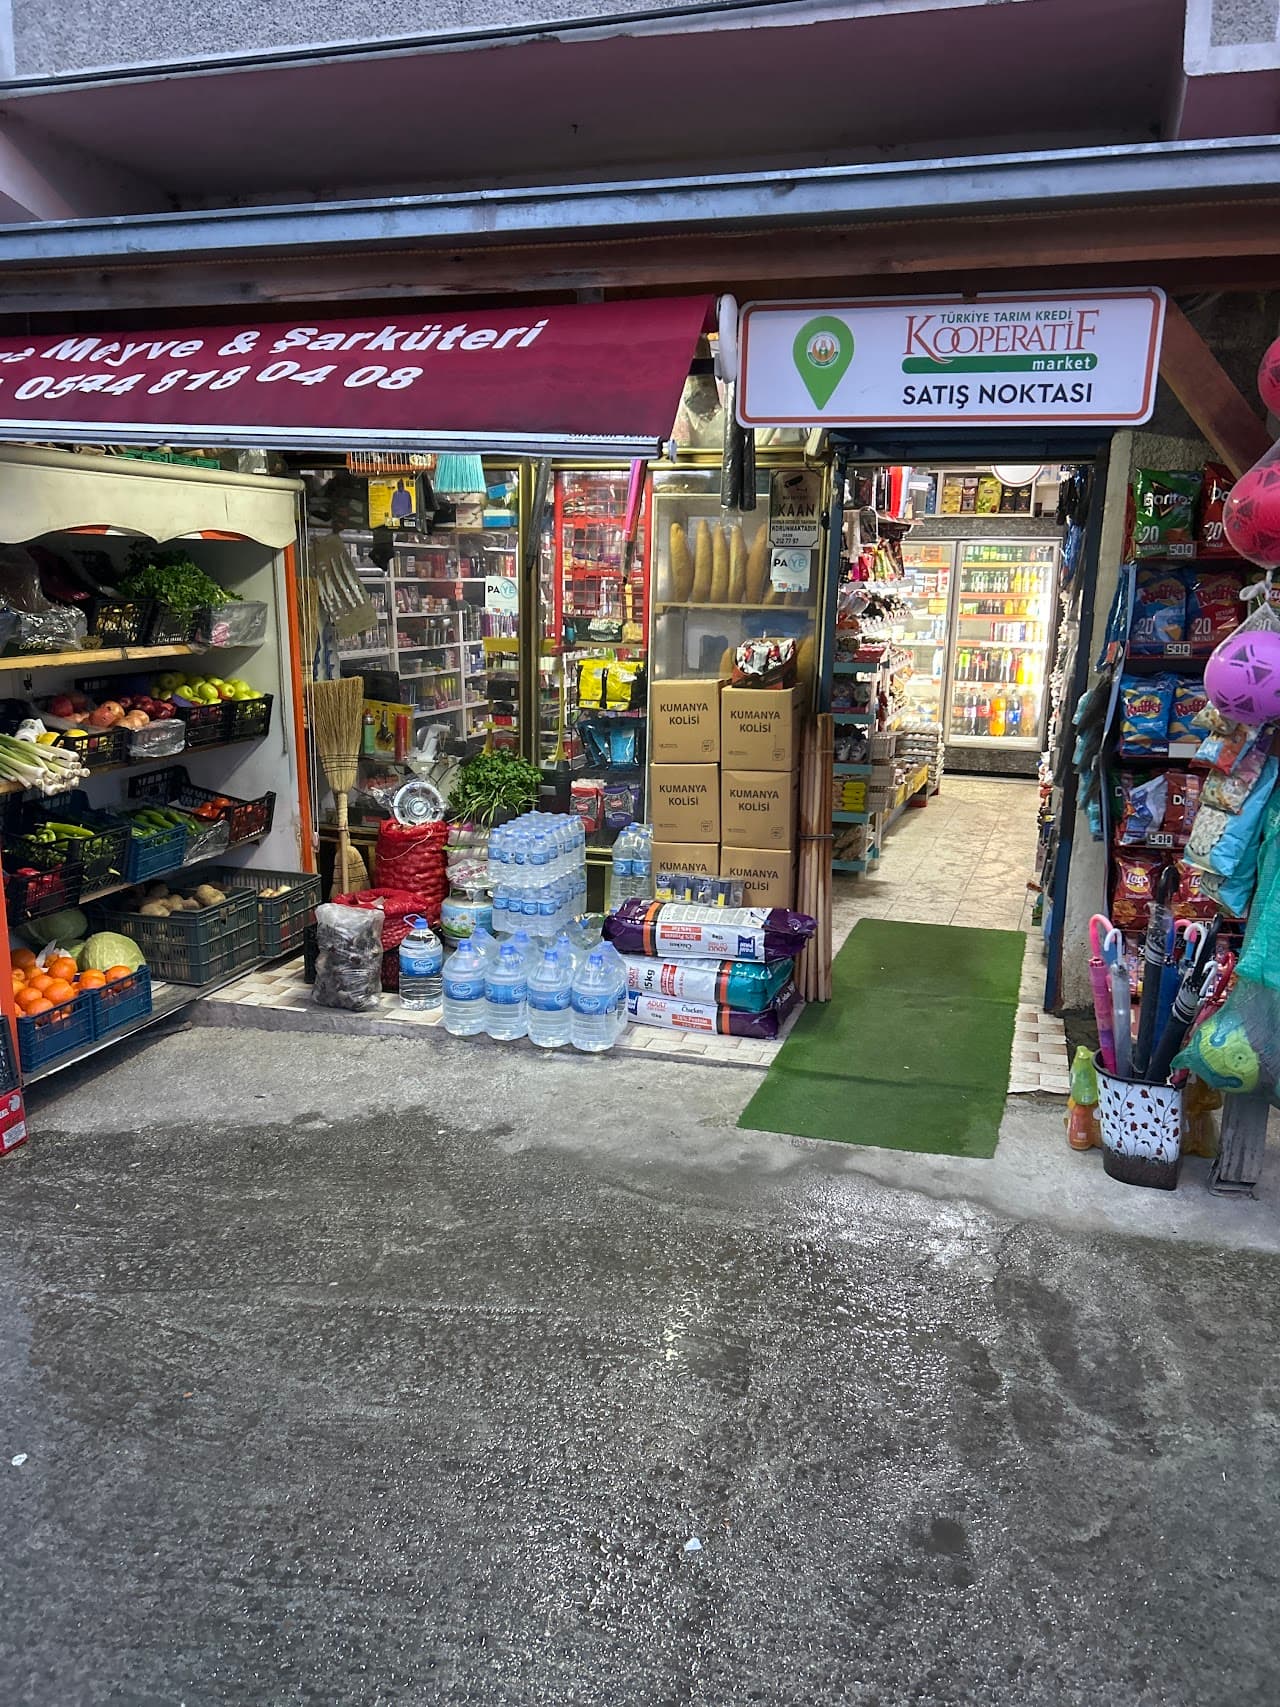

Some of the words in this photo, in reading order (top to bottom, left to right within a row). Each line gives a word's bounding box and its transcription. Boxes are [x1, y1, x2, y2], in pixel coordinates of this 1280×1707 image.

[941, 310, 990, 324] TÜRKİYE
[994, 312, 1031, 323] TARIM
[1035, 307, 1072, 321] KREDİ
[40, 337, 204, 367] Meyve
[217, 330, 261, 355] &
[269, 319, 549, 353] Şarküteri
[1032, 355, 1091, 371] market
[256, 360, 338, 386] 04
[343, 365, 424, 390] 08
[902, 384, 969, 409] SATIŞ
[979, 383, 1092, 404] NOKTASI
[777, 503, 815, 517] KAAN
[660, 702, 709, 712] KUMANYA
[669, 714, 700, 725] KOLİSİ
[730, 710, 781, 720] KUMANYA
[739, 722, 771, 733] KOLİSİ
[659, 784, 707, 793] KUMANYA
[729, 789, 780, 799] KUMANYA
[668, 797, 699, 806] KOLİSİ
[738, 802, 770, 812] KOLİSİ
[659, 862, 708, 872] KUMANYA
[729, 868, 779, 879] KUMANYA
[744, 881, 769, 891] OLİSİ
